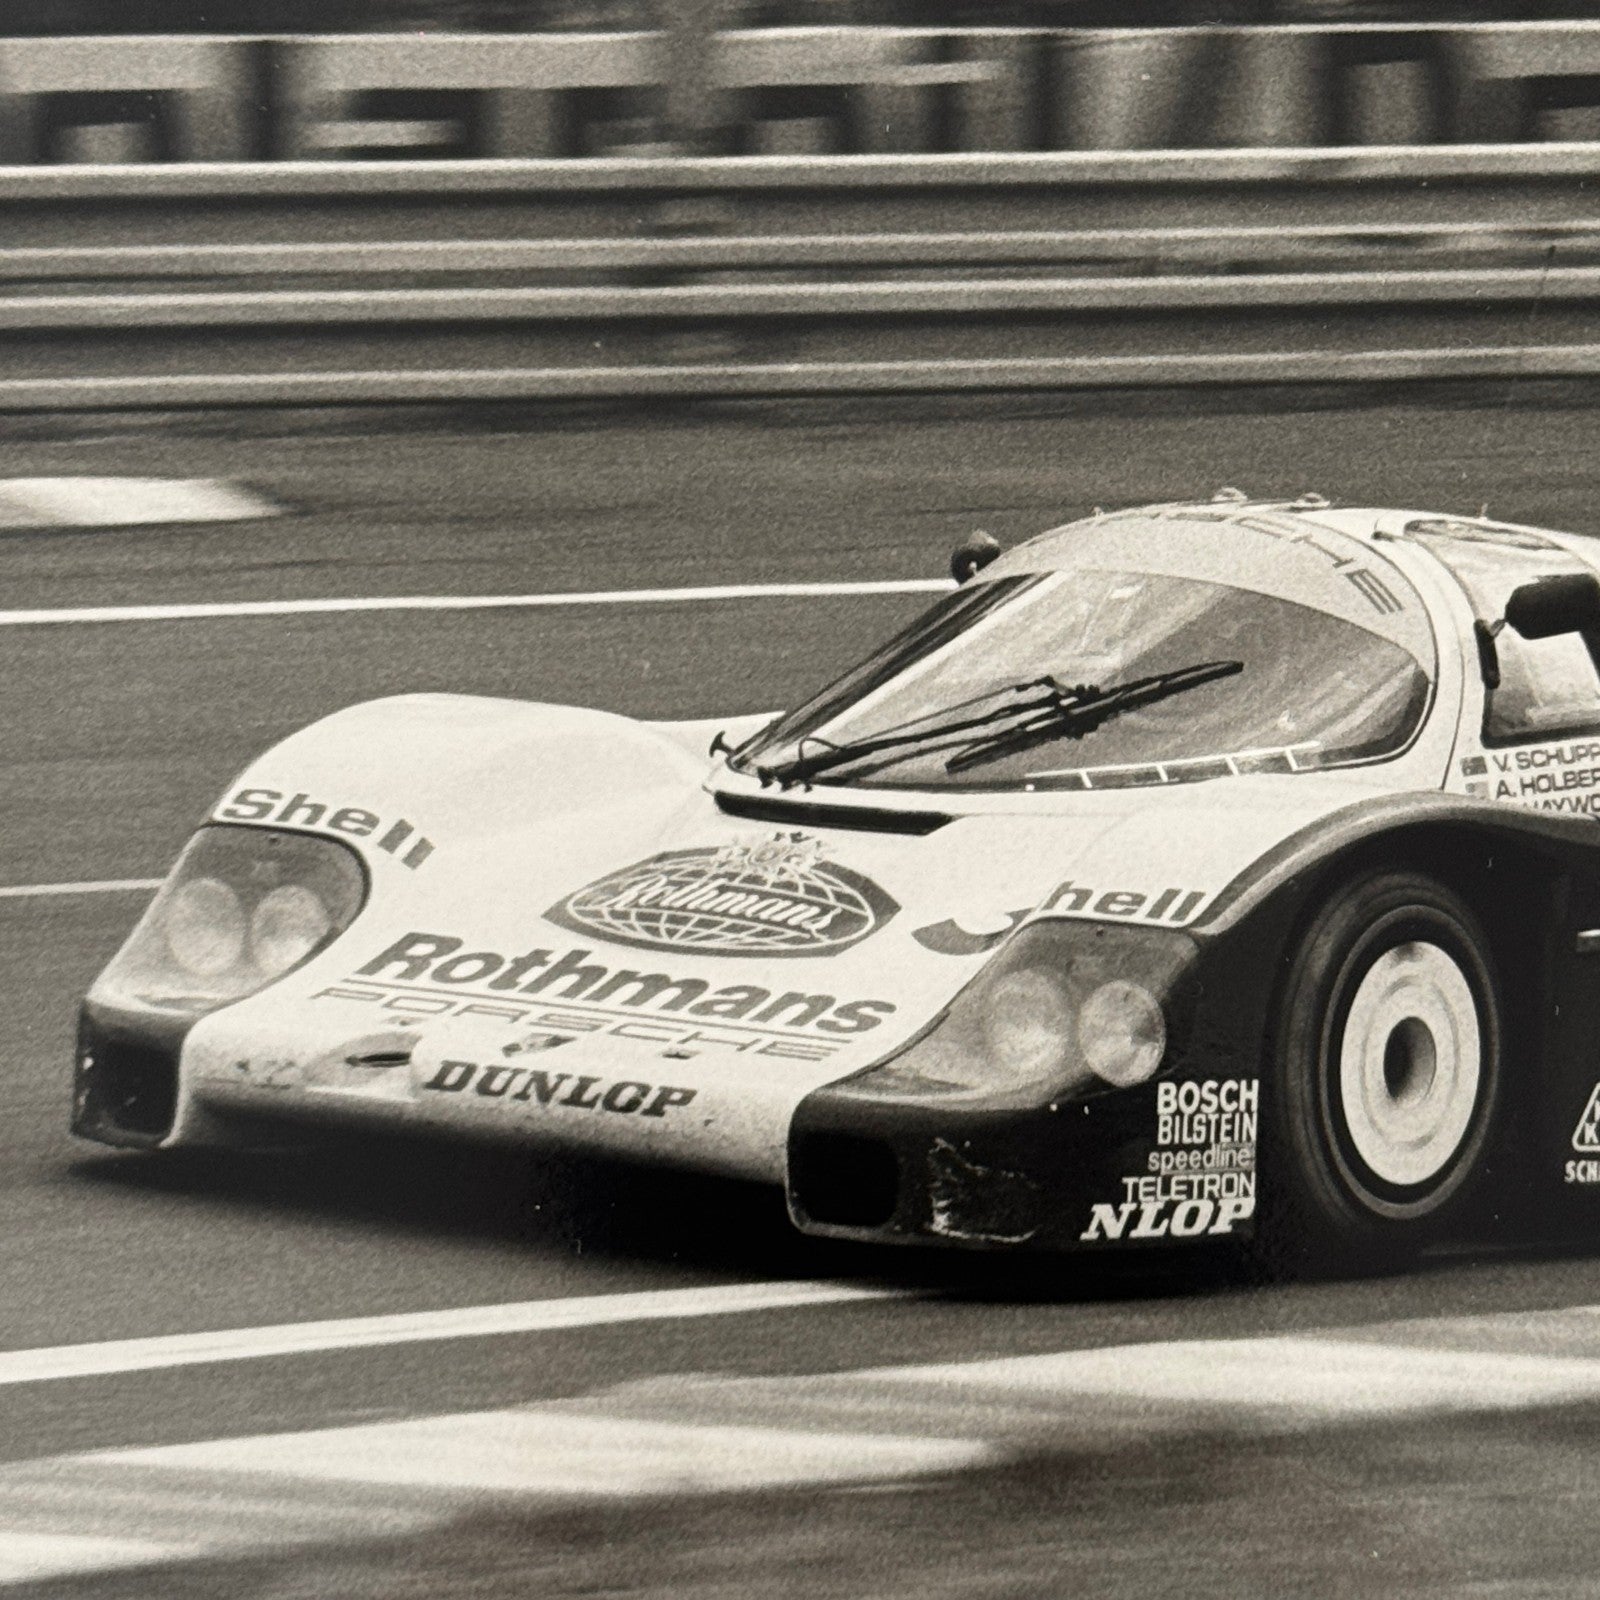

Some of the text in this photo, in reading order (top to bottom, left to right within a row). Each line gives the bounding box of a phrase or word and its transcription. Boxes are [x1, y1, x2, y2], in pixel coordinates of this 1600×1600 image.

[1492, 753, 1512, 773] V.
[1496, 779, 1517, 799] A.
[221, 788, 436, 871] Shell
[1039, 879, 1207, 921] hell
[355, 931, 898, 1034] Rothmans
[309, 986, 842, 1062] PORSCHE
[425, 1060, 698, 1118] DUNLOP
[1156, 1079, 1260, 1115] BOSCH
[1157, 1112, 1258, 1146] BILSTEIN
[1147, 1143, 1251, 1176] speedline
[1563, 1160, 1600, 1184] SCH
[1121, 1171, 1257, 1204] TELETRON
[1079, 1197, 1257, 1241] NLOP
